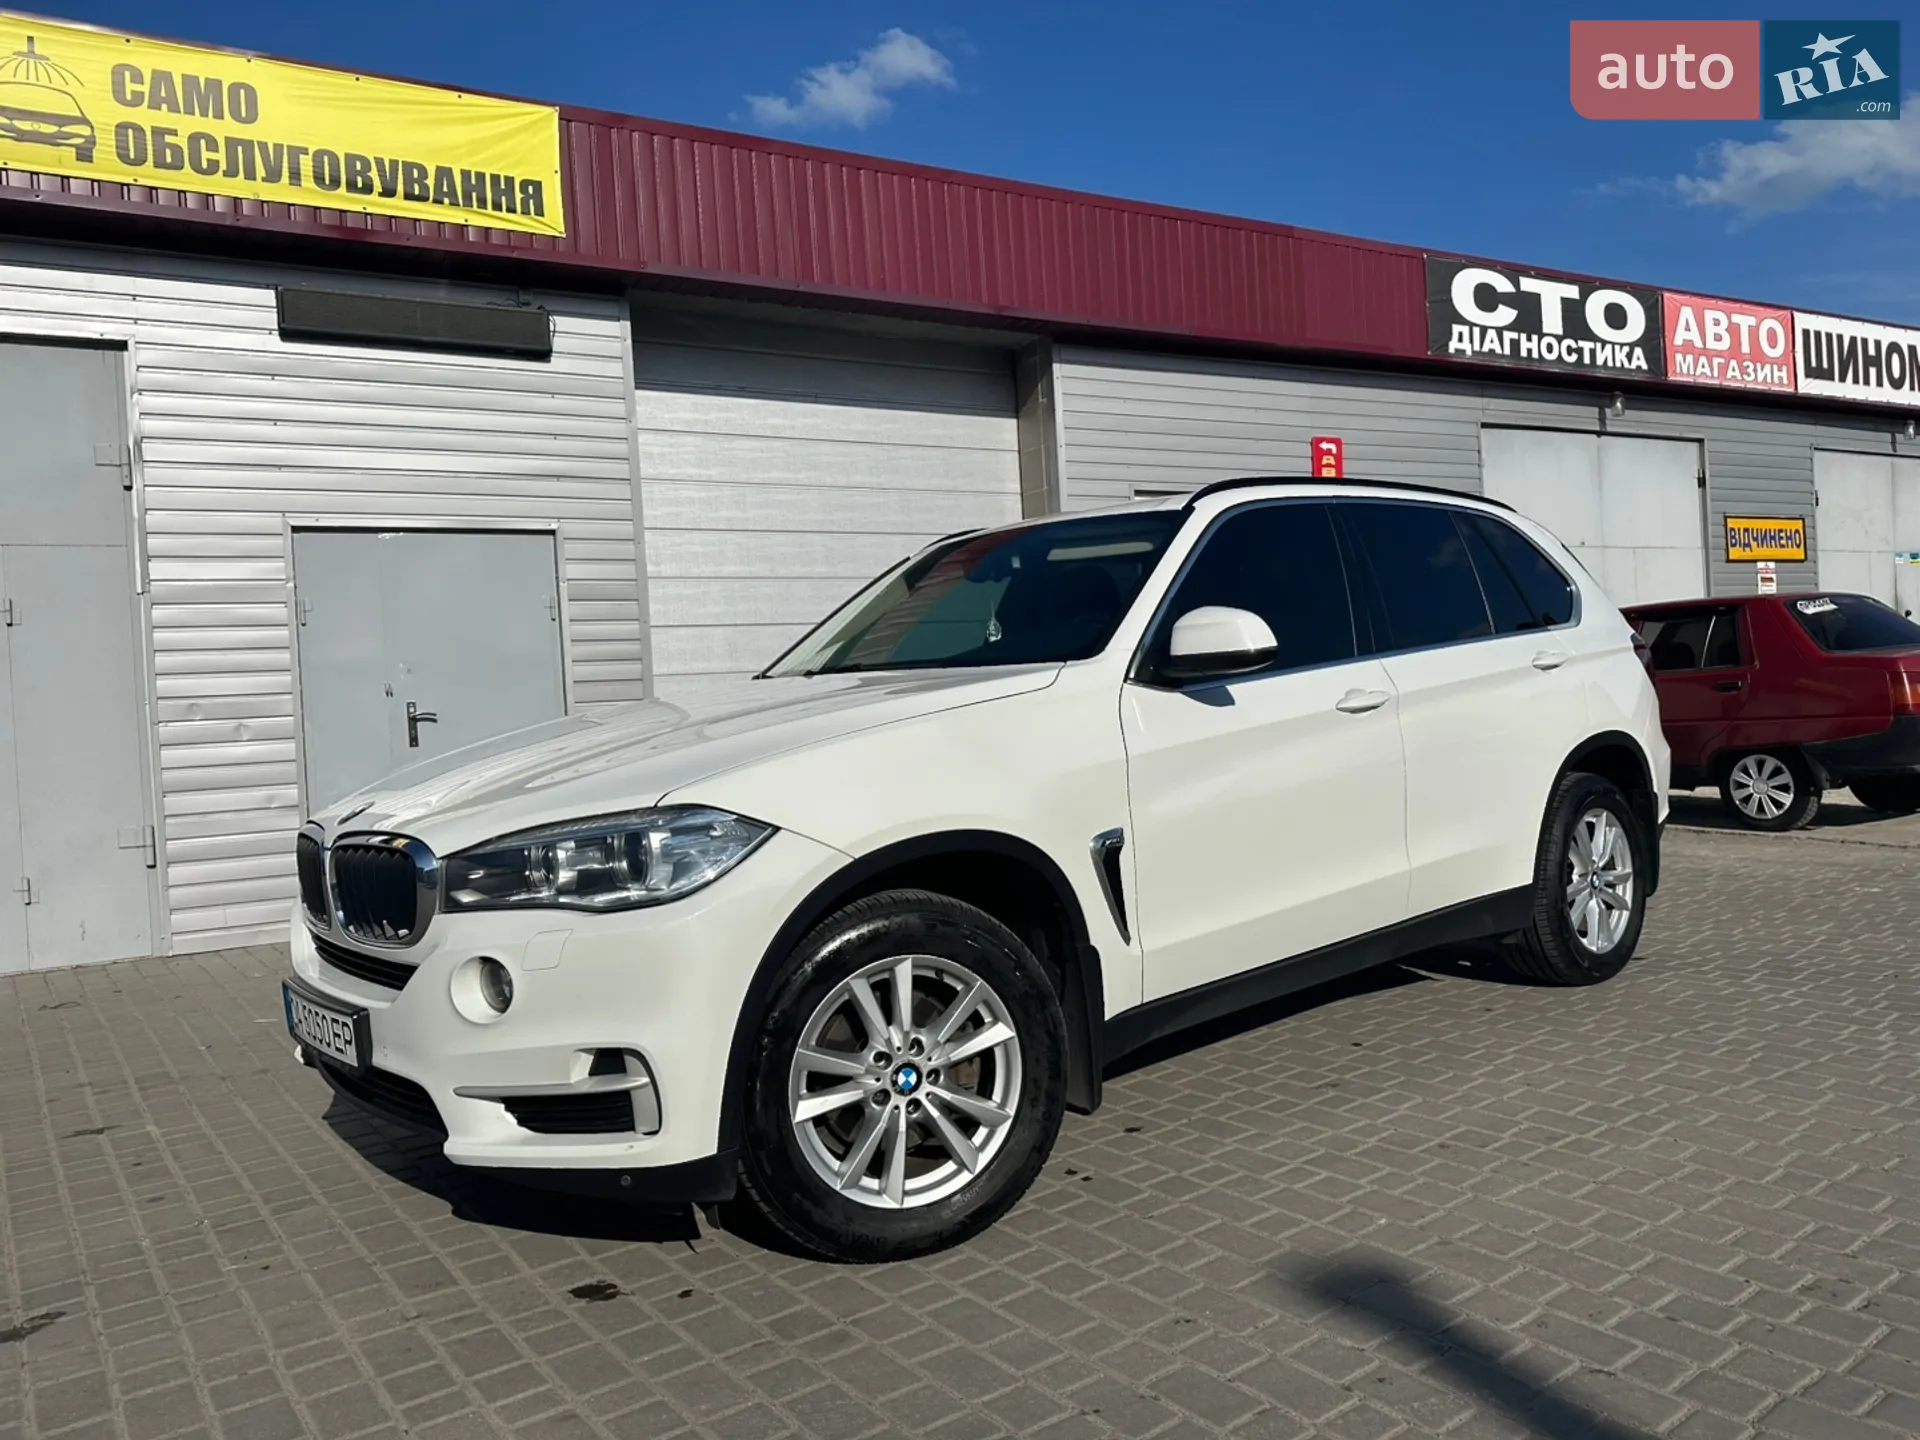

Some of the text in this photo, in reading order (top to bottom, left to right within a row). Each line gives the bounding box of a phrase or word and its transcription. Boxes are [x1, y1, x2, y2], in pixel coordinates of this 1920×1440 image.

[110, 62, 259, 125] САМО
[114, 121, 545, 218] ОБСЛУГОВУВАННЯ
[1450, 267, 1647, 344] СТО
[1673, 304, 1787, 359] АВТО
[1448, 323, 1649, 371] ДІАГНОСТИКА
[1674, 351, 1788, 386] МАГАЗИН
[1728, 526, 1802, 552] ВІДЧИНЕНО
